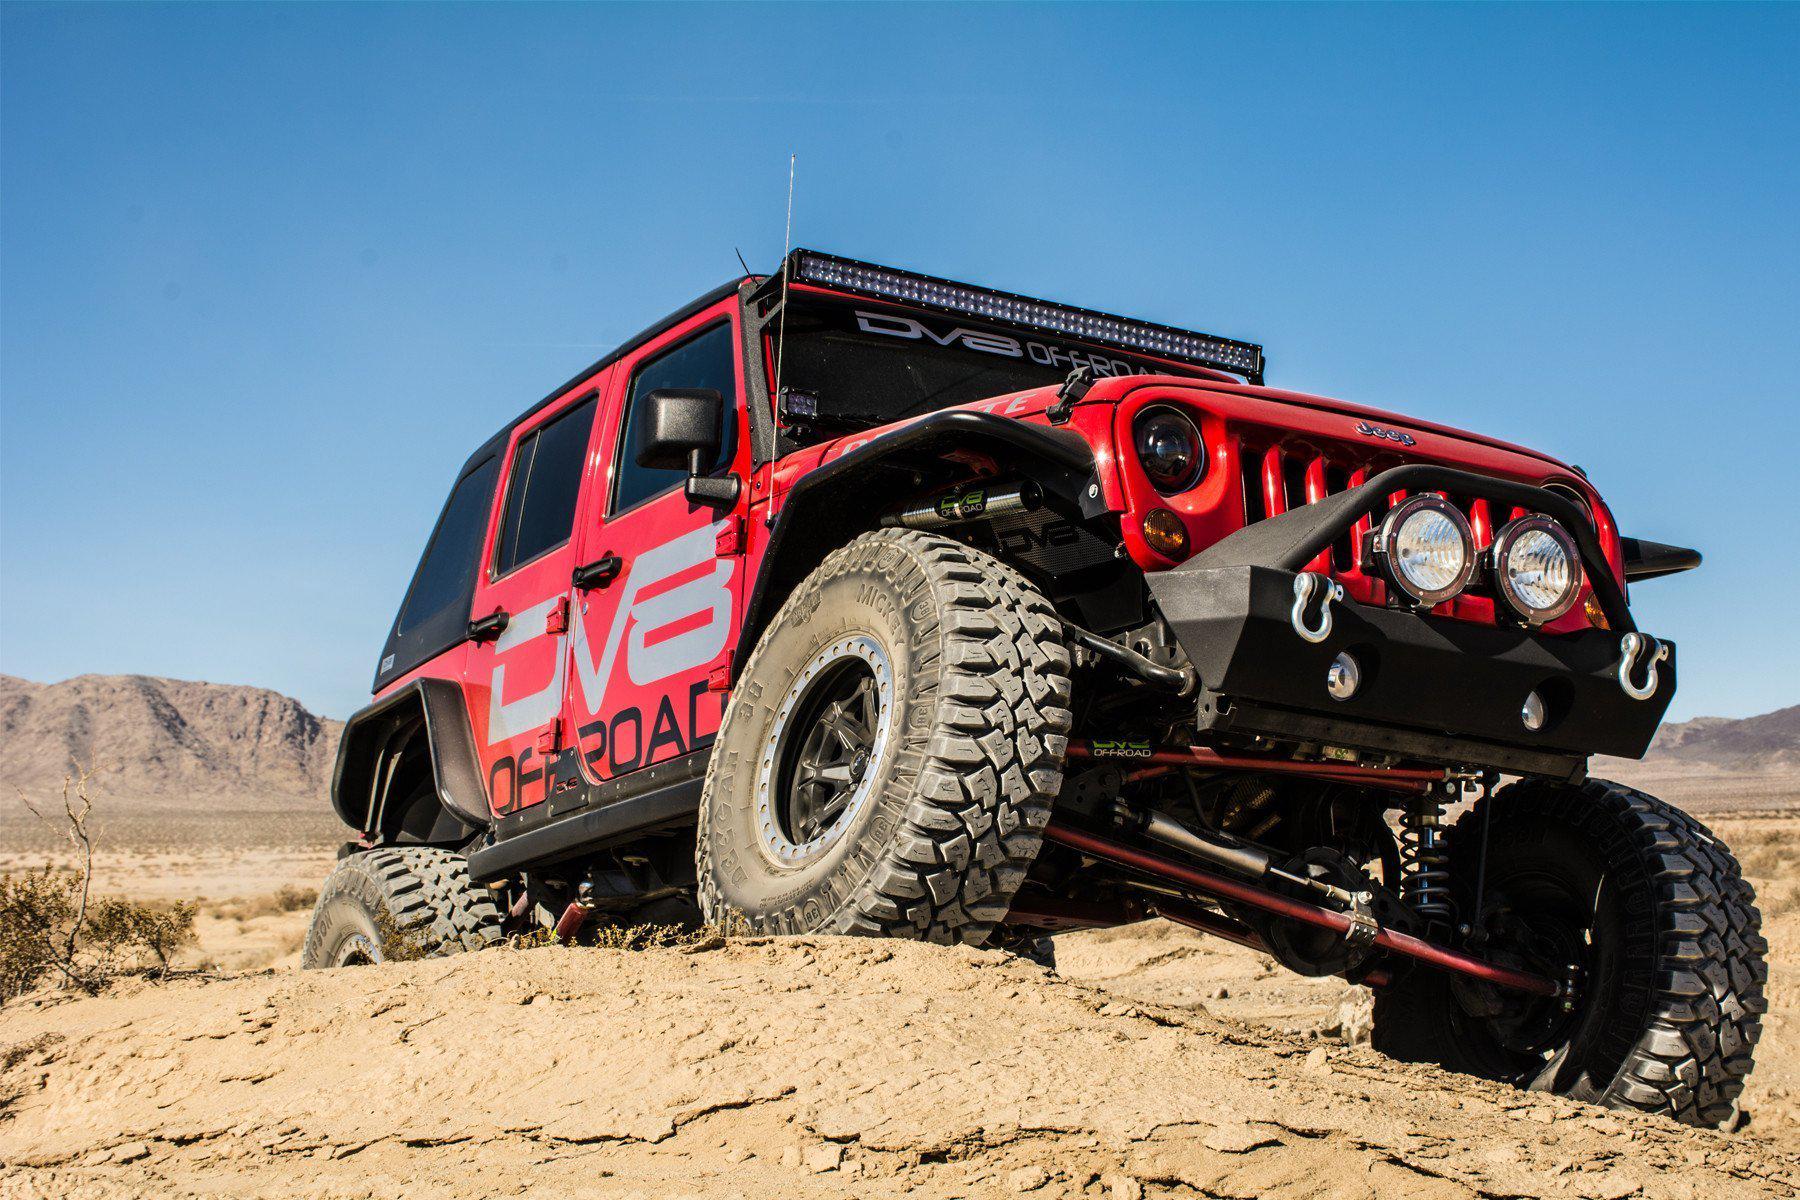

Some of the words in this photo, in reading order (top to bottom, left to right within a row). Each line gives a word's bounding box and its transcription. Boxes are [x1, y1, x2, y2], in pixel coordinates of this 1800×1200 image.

[854, 310, 1023, 358] DV8
[1027, 340, 1172, 378] OFFRO
[1355, 421, 1415, 446] Jeep
[488, 519, 735, 745] DV8
[856, 583, 905, 646] MICKEY
[1093, 748, 1152, 757] OFFROAD
